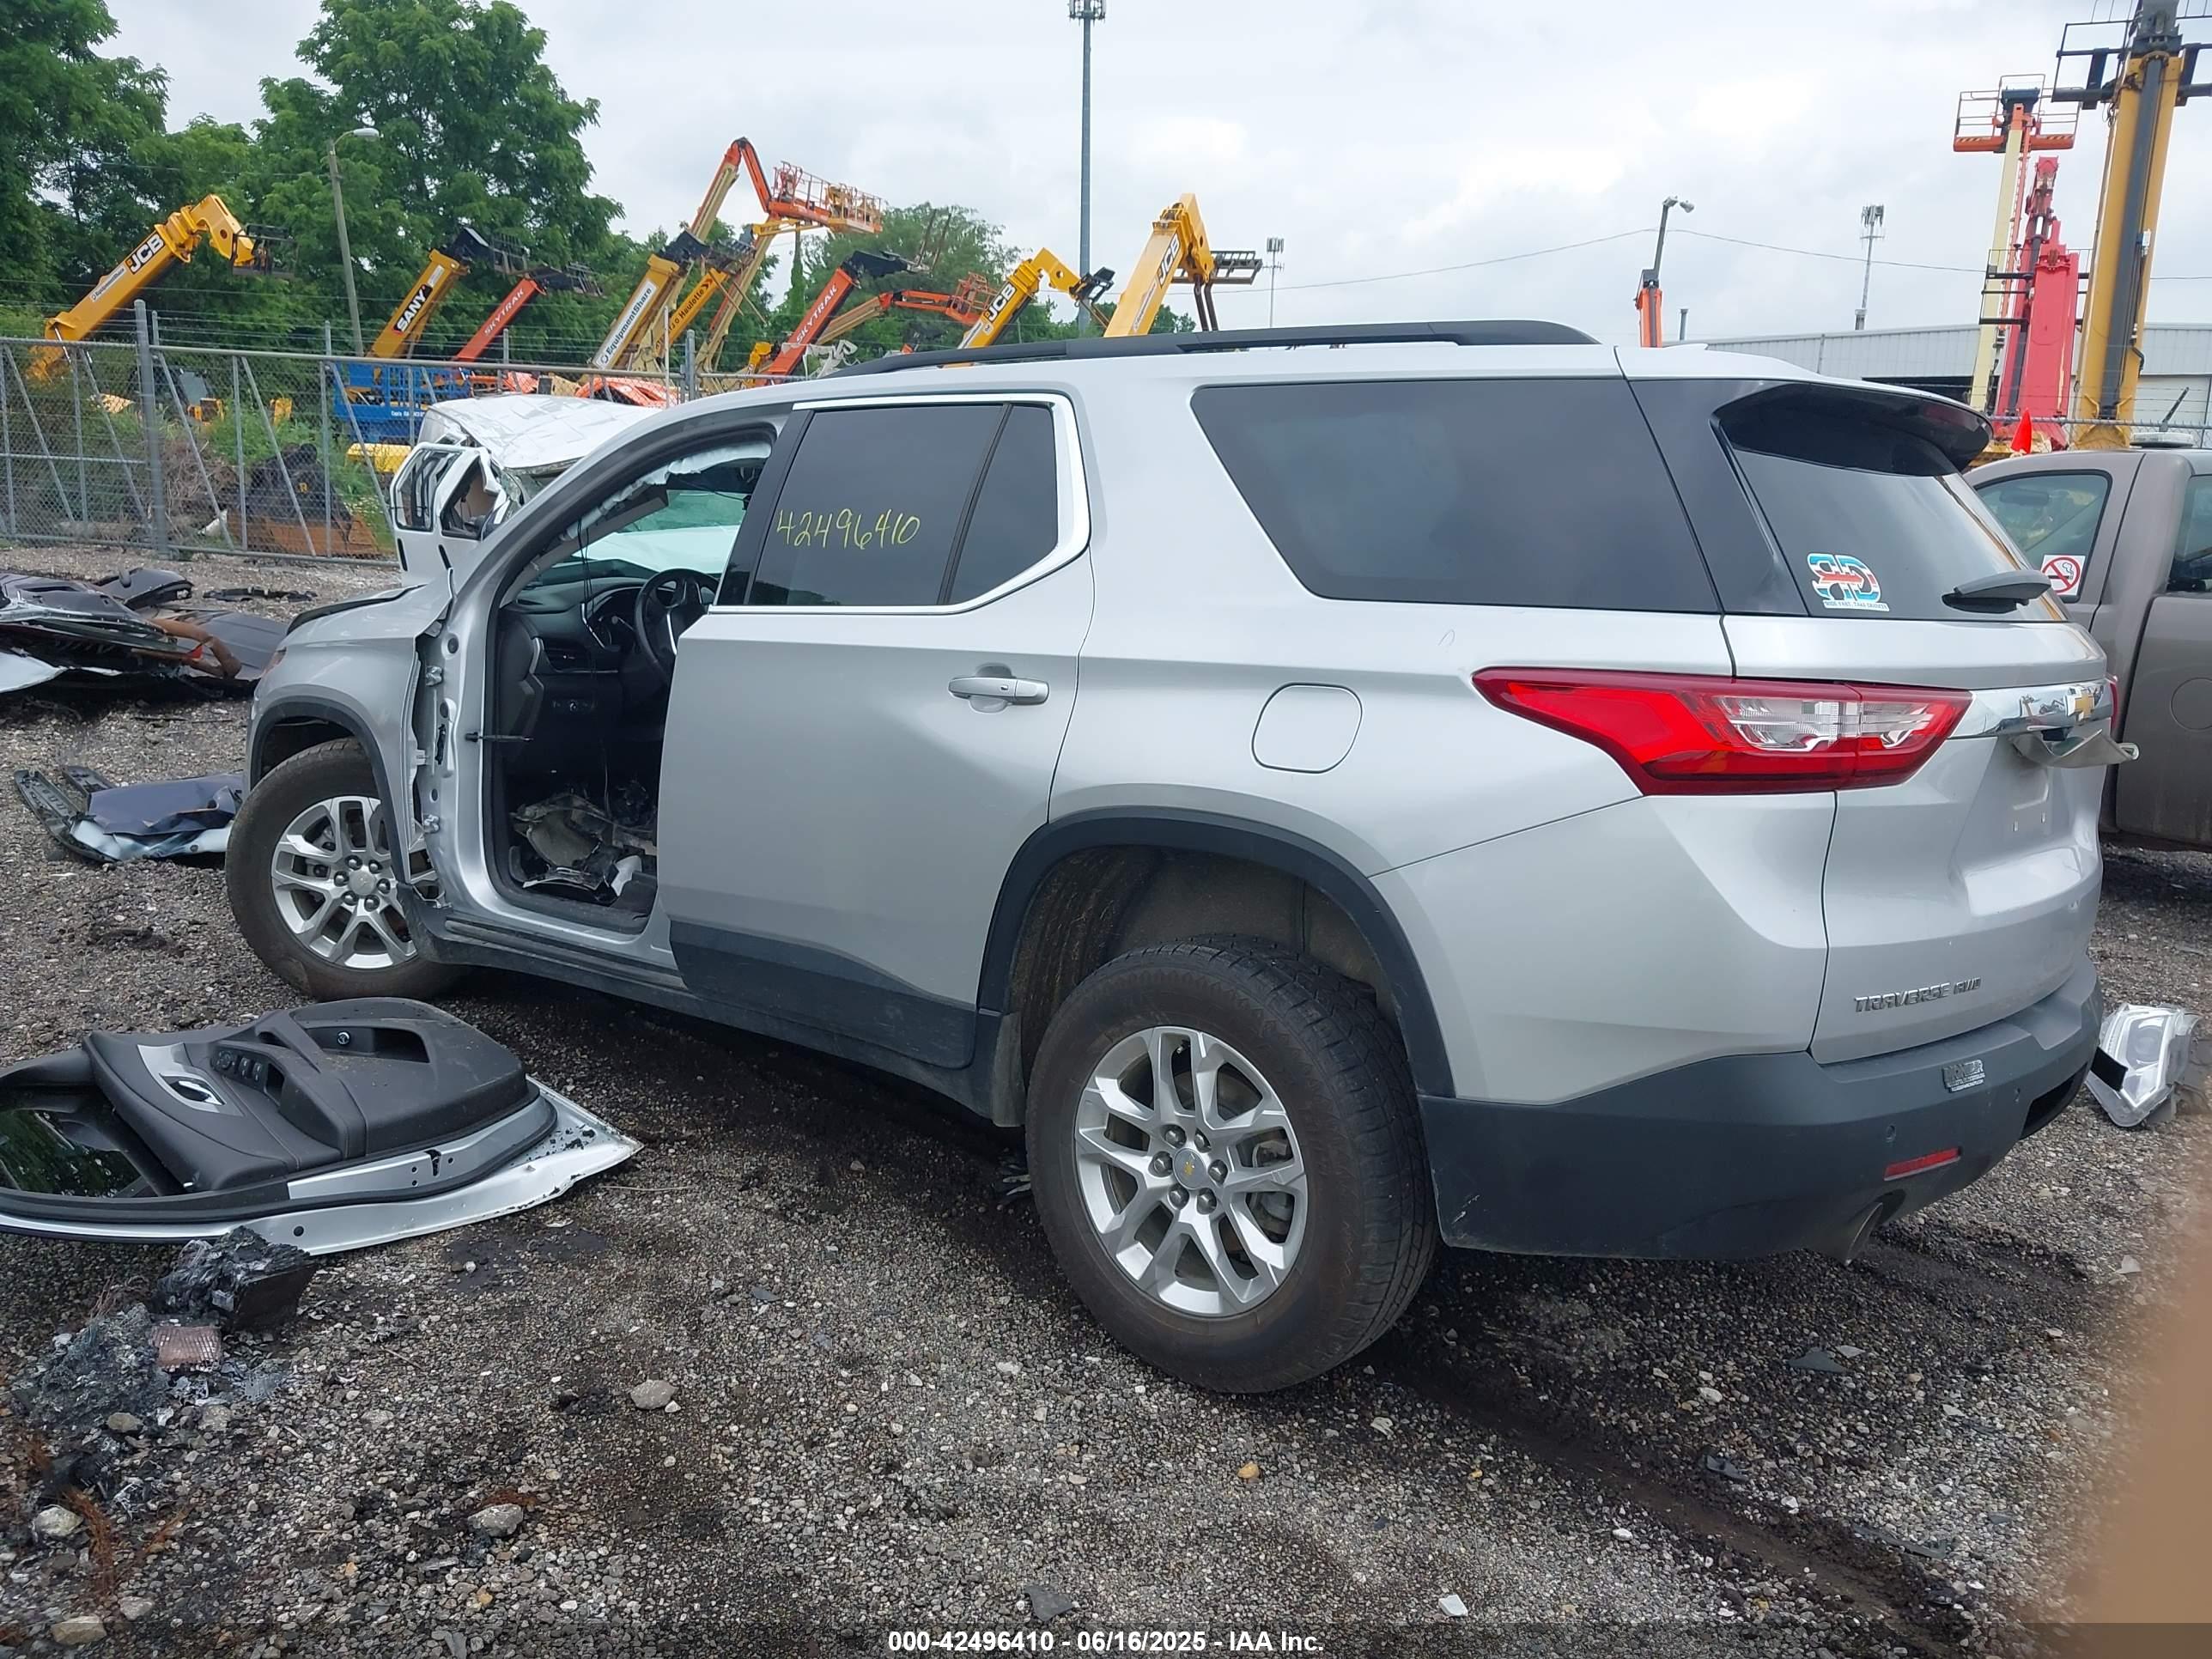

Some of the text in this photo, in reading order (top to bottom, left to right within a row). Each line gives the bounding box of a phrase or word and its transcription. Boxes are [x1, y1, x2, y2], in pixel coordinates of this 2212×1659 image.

[130, 233, 164, 273] JCB
[1159, 233, 1180, 286] JCB
[396, 289, 428, 331] SANY
[484, 288, 525, 336] SKYTRAK
[605, 287, 653, 356] EquipmentShare
[796, 283, 838, 344] SKYTRAK
[988, 283, 1016, 322] JCB
[776, 507, 921, 550] 42496410
[1854, 976, 1982, 1012] TRAVERSE AWD
